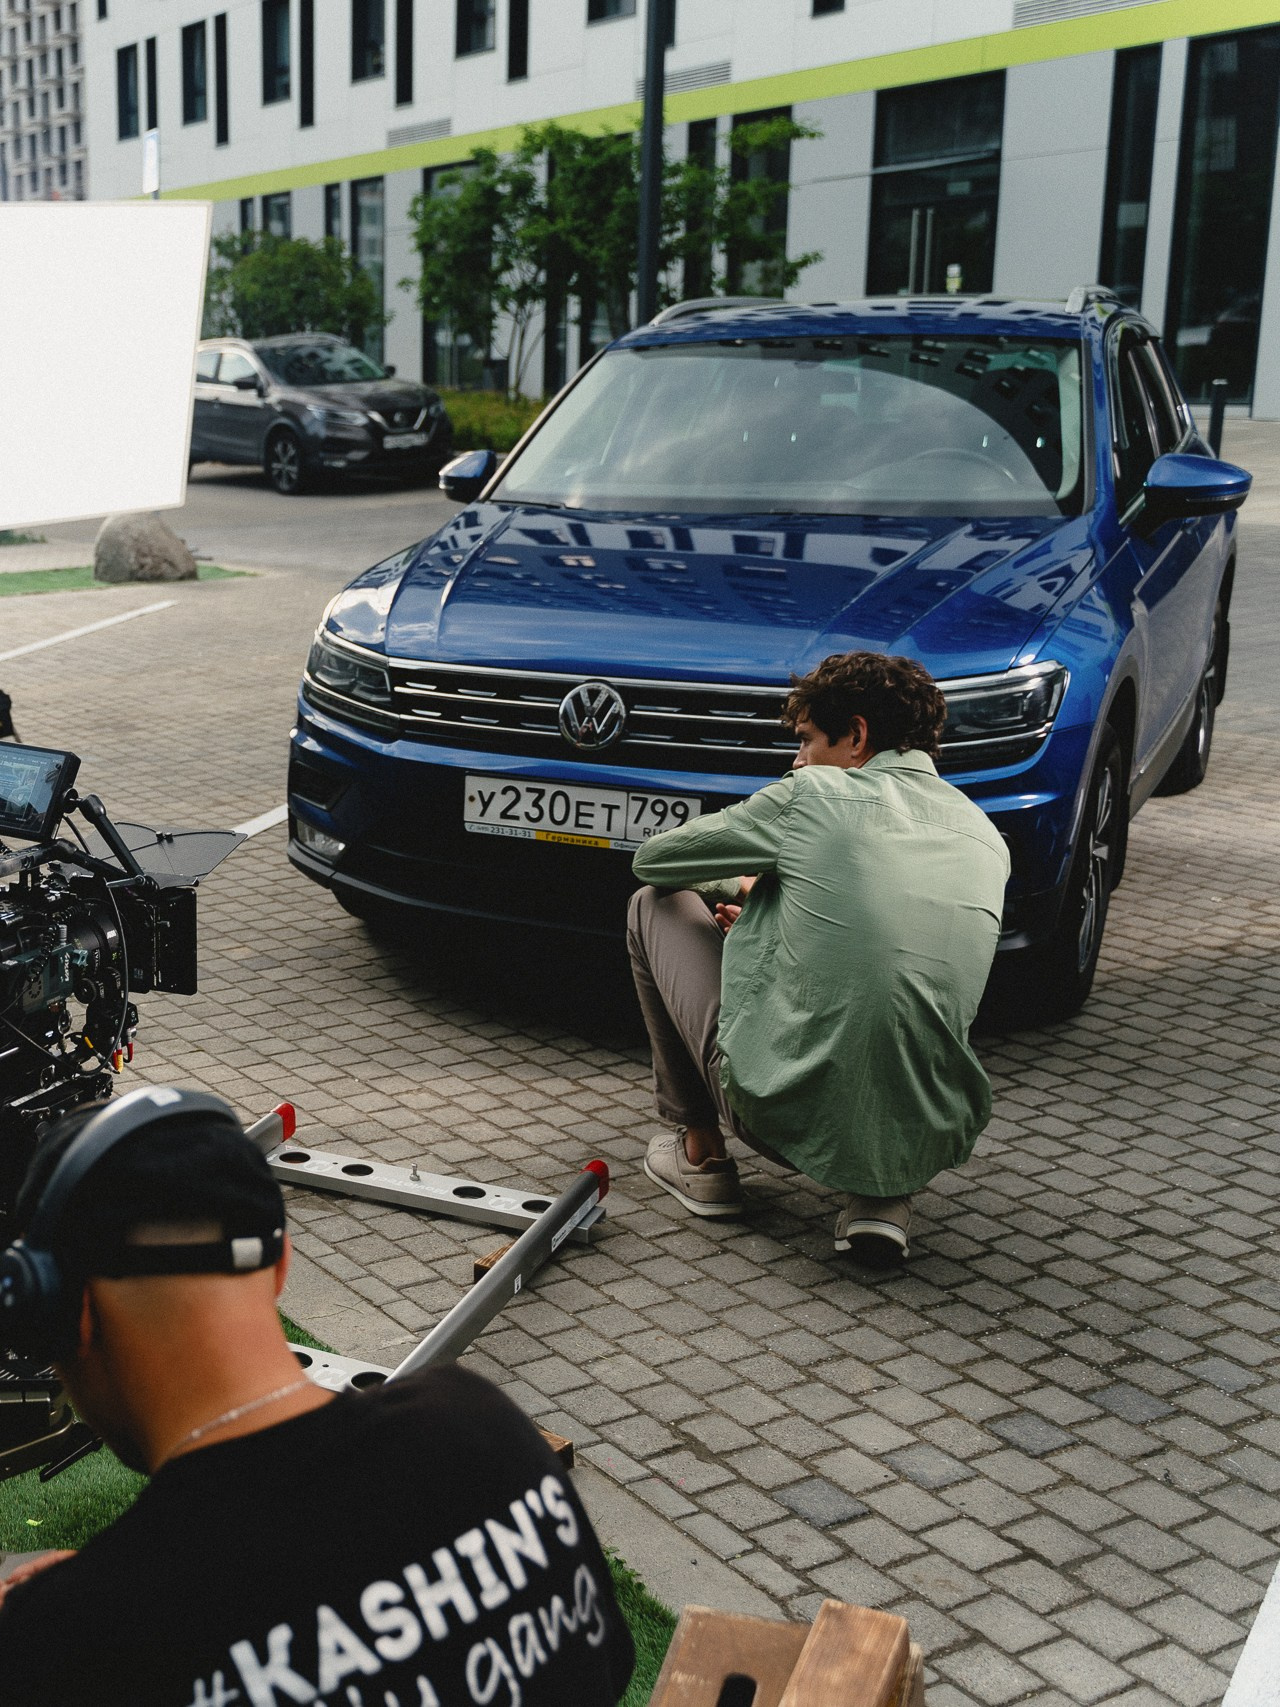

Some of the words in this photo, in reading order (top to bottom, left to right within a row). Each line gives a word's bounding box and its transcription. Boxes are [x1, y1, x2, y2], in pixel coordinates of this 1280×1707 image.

[630, 795, 690, 828] 799
[490, 826, 532, 838] 231-31-31
[545, 832, 600, 847] Германика
[642, 827, 670, 838] RU
[466, 1563, 606, 1707] gang
